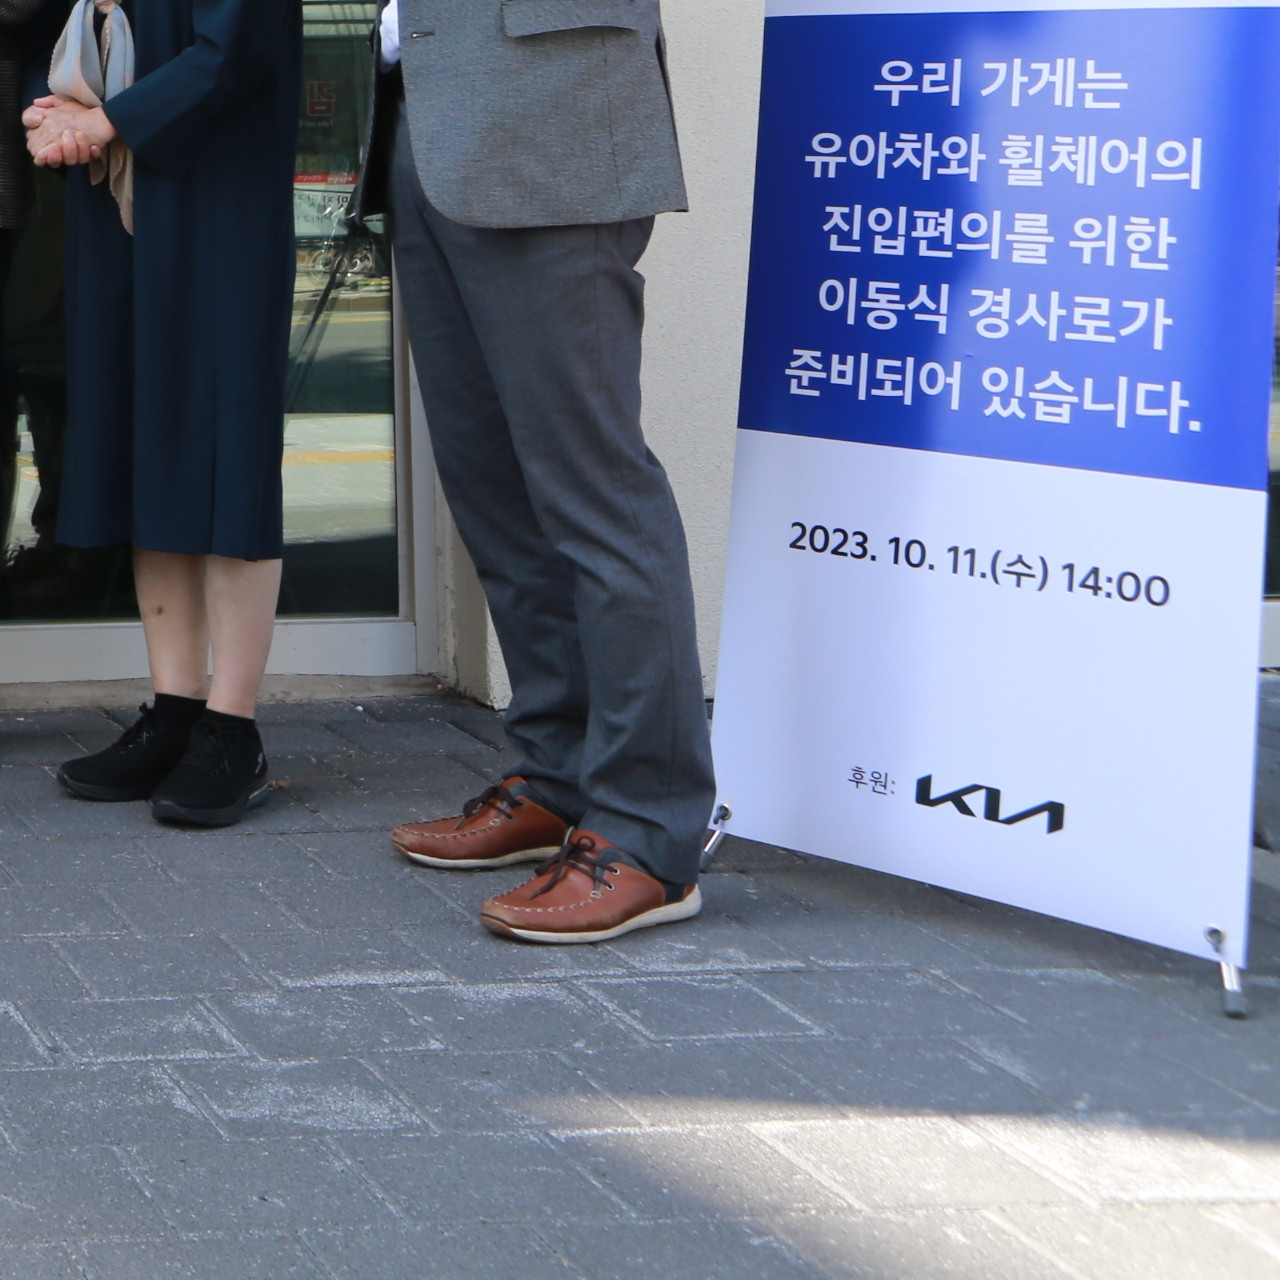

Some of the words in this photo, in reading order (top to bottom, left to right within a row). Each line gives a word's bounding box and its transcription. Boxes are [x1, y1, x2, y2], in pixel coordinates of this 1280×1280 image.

[873, 56, 963, 109] 우리
[979, 58, 1128, 111] 가게는
[804, 130, 986, 184] 유아차와
[997, 134, 1203, 190] 휠체어의
[822, 205, 1056, 266] 진입편의를
[1068, 215, 1177, 271] 위한
[818, 277, 951, 336] 이동식
[967, 285, 1173, 352] 경사로가
[783, 348, 963, 411] 준비되어
[981, 364, 1203, 437] 있습니다.
[788, 521, 878, 565] 2023.
[887, 536, 935, 572] 10.
[946, 544, 1050, 592] 11.(수)
[1060, 559, 1172, 609] 14:00
[847, 765, 897, 800] 후원:
[915, 772, 1066, 836] KIA
